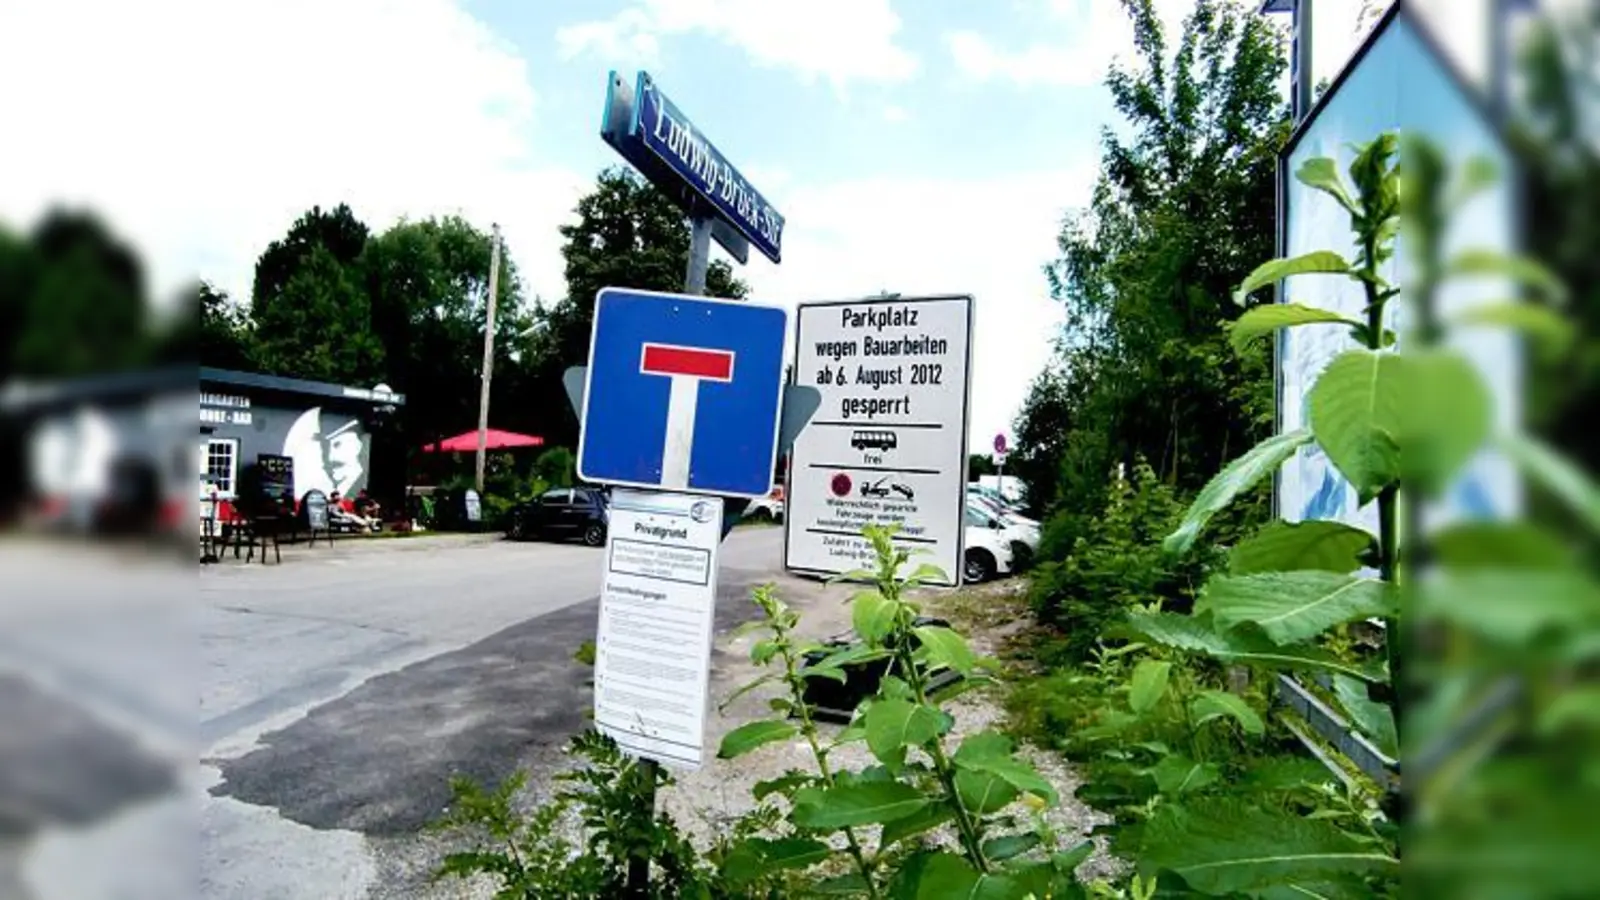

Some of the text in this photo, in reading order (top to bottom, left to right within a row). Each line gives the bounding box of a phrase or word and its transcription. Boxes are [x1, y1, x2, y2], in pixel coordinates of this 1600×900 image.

[842, 306, 919, 332] Parkplatz
[815, 334, 947, 361] wegen Bauarbeiten
[816, 363, 943, 391] ab 6. August 2012
[841, 395, 910, 419] gesperrt
